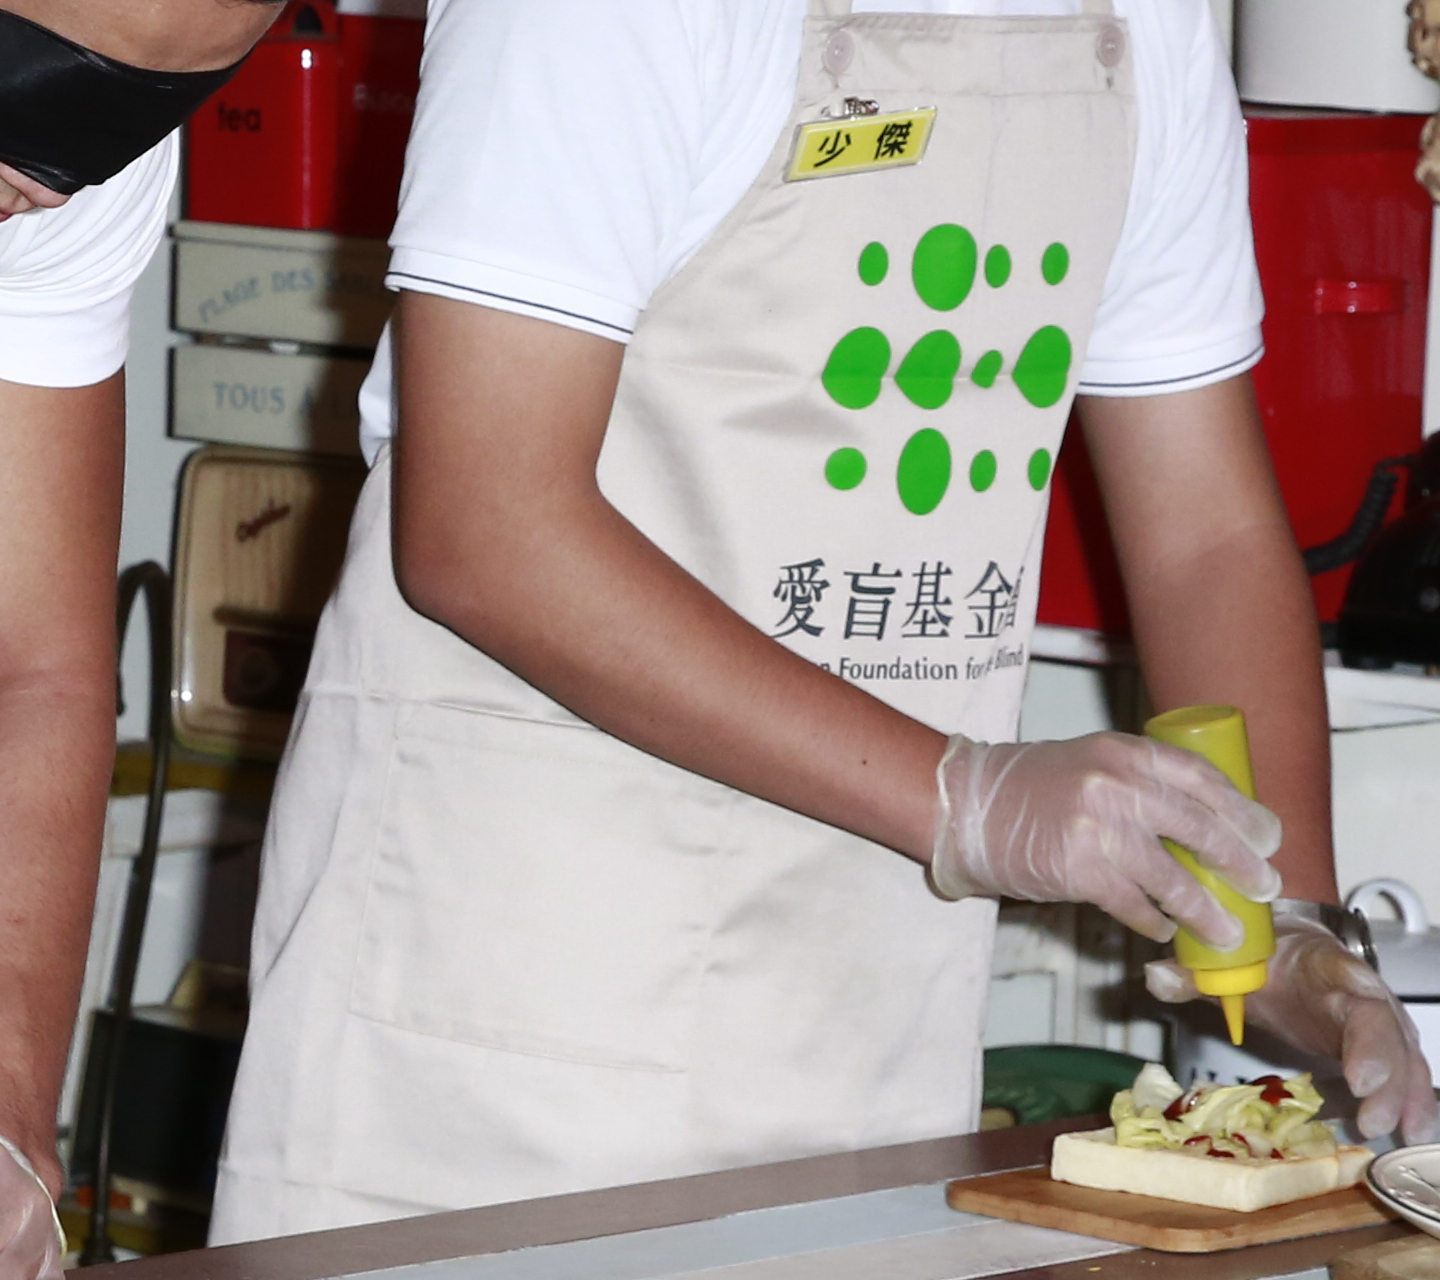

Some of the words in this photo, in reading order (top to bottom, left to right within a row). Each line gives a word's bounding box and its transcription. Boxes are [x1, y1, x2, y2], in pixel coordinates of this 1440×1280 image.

[215, 99, 262, 133] tea
[815, 119, 913, 167] 少傑
[270, 267, 318, 293] DES
[211, 380, 286, 414] TOUS
[838, 656, 959, 681] Foundation
